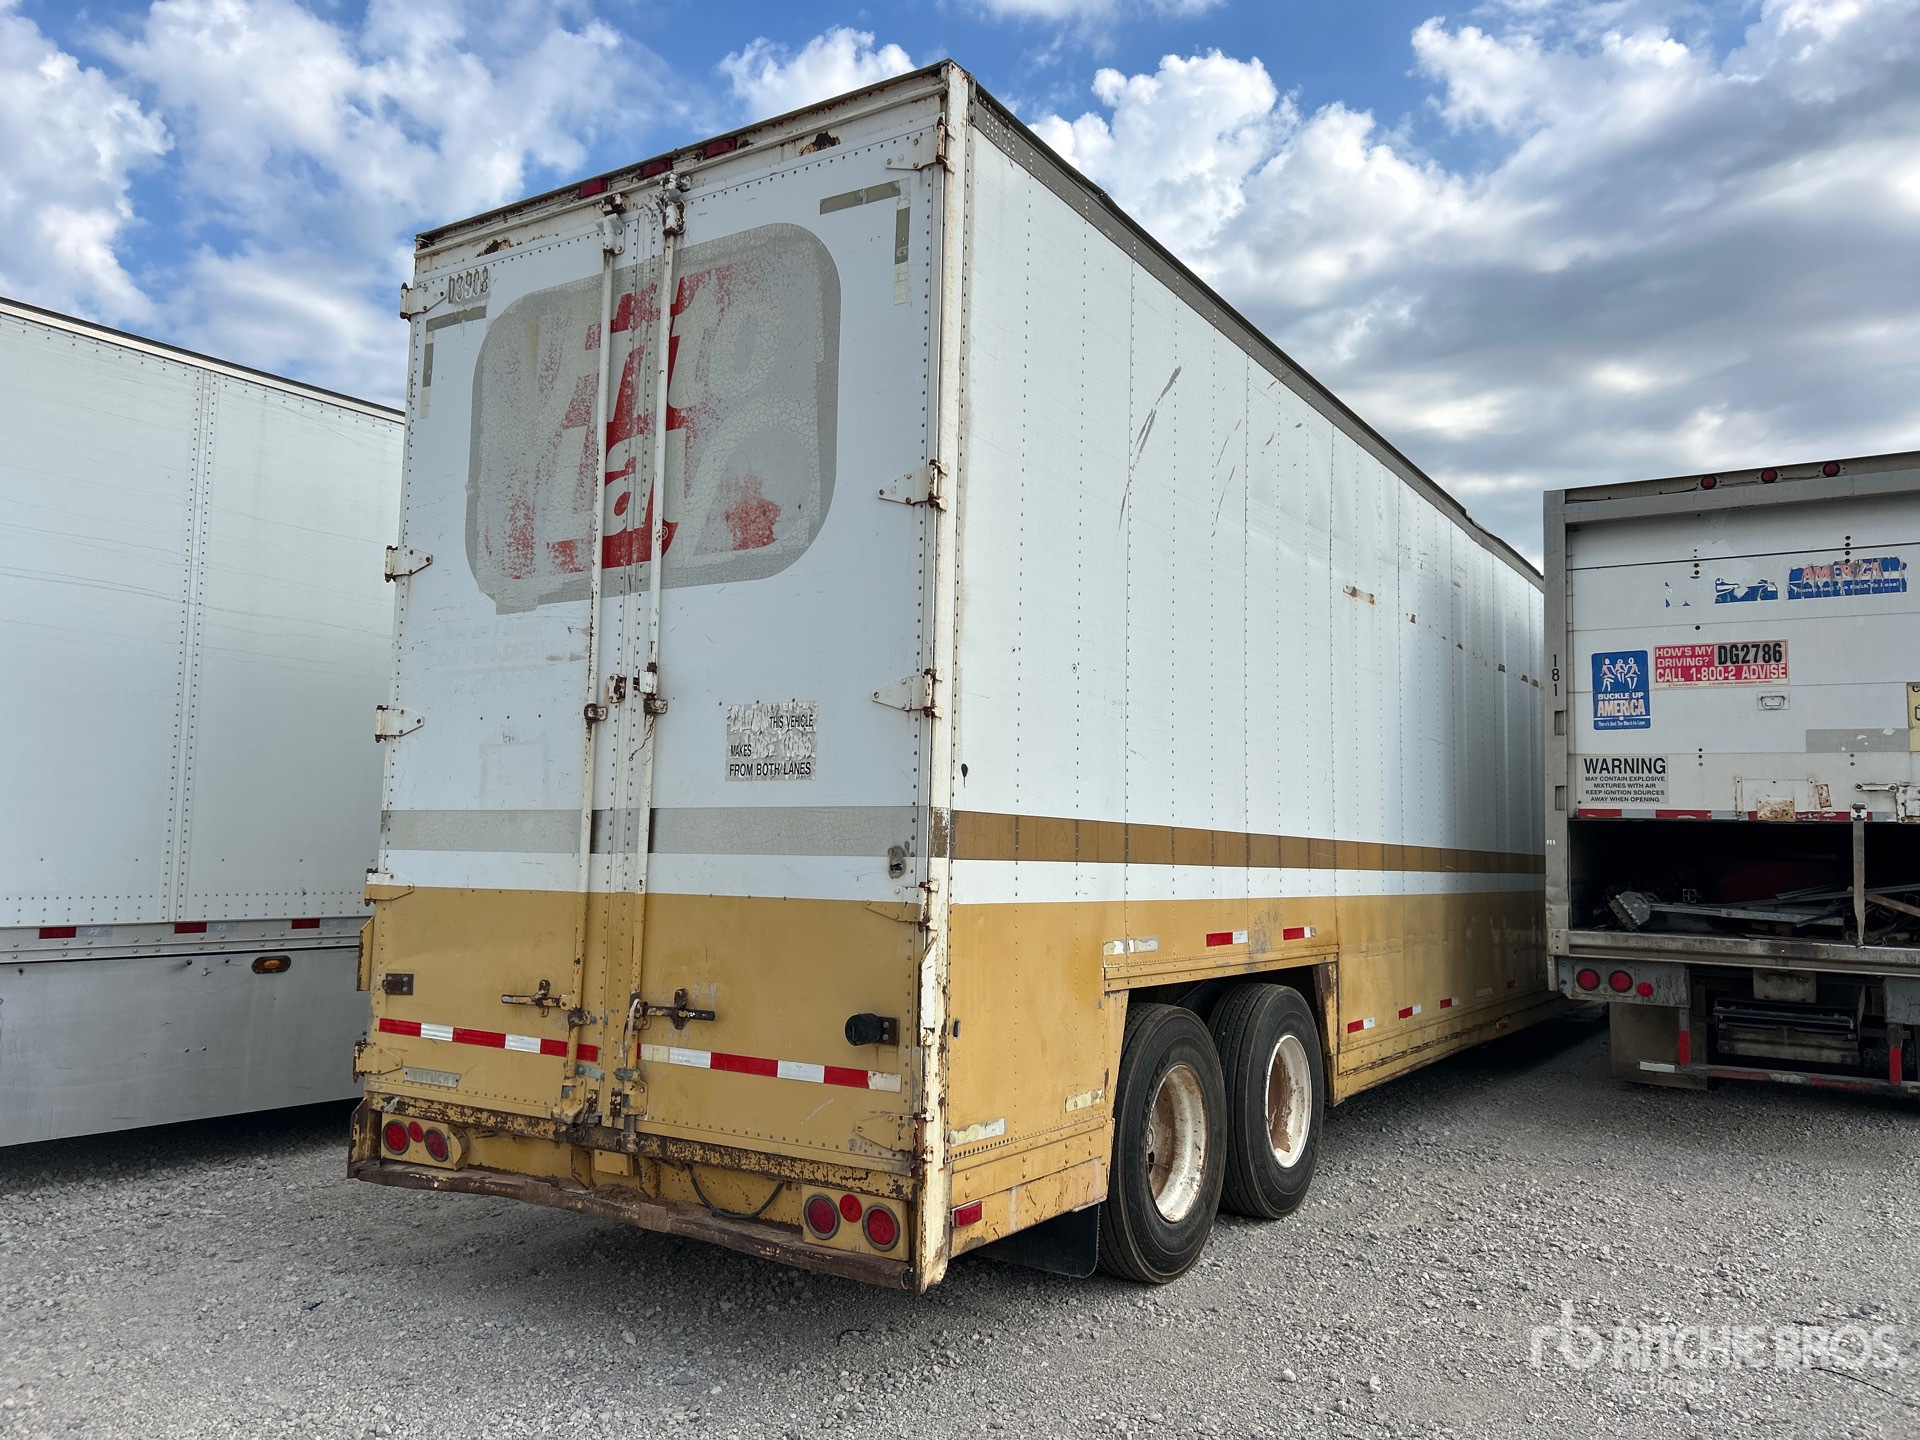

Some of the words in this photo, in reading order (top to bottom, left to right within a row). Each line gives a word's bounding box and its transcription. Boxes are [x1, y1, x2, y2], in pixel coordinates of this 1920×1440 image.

[1802, 561, 1884, 580] AMERCA
[1656, 647, 1692, 657] HOW'S
[1695, 645, 1713, 656] MY
[1718, 643, 1783, 665] DG2786
[1657, 656, 1710, 668] DRIVING?
[1656, 668, 1685, 682] CALL
[1690, 666, 1736, 681] 1-800-2
[1741, 664, 1787, 680] ADVISE
[1597, 692, 1630, 700] BUCKLE
[1632, 691, 1645, 699] UP
[1597, 699, 1646, 717] AMERICA
[769, 715, 784, 729] THIS
[786, 714, 814, 728] VEHICLE
[730, 743, 752, 757] MAKES
[729, 763, 754, 777] FROM
[756, 762, 780, 776] BOTH
[783, 761, 812, 775] LANES
[1583, 757, 1666, 775] WARNING
